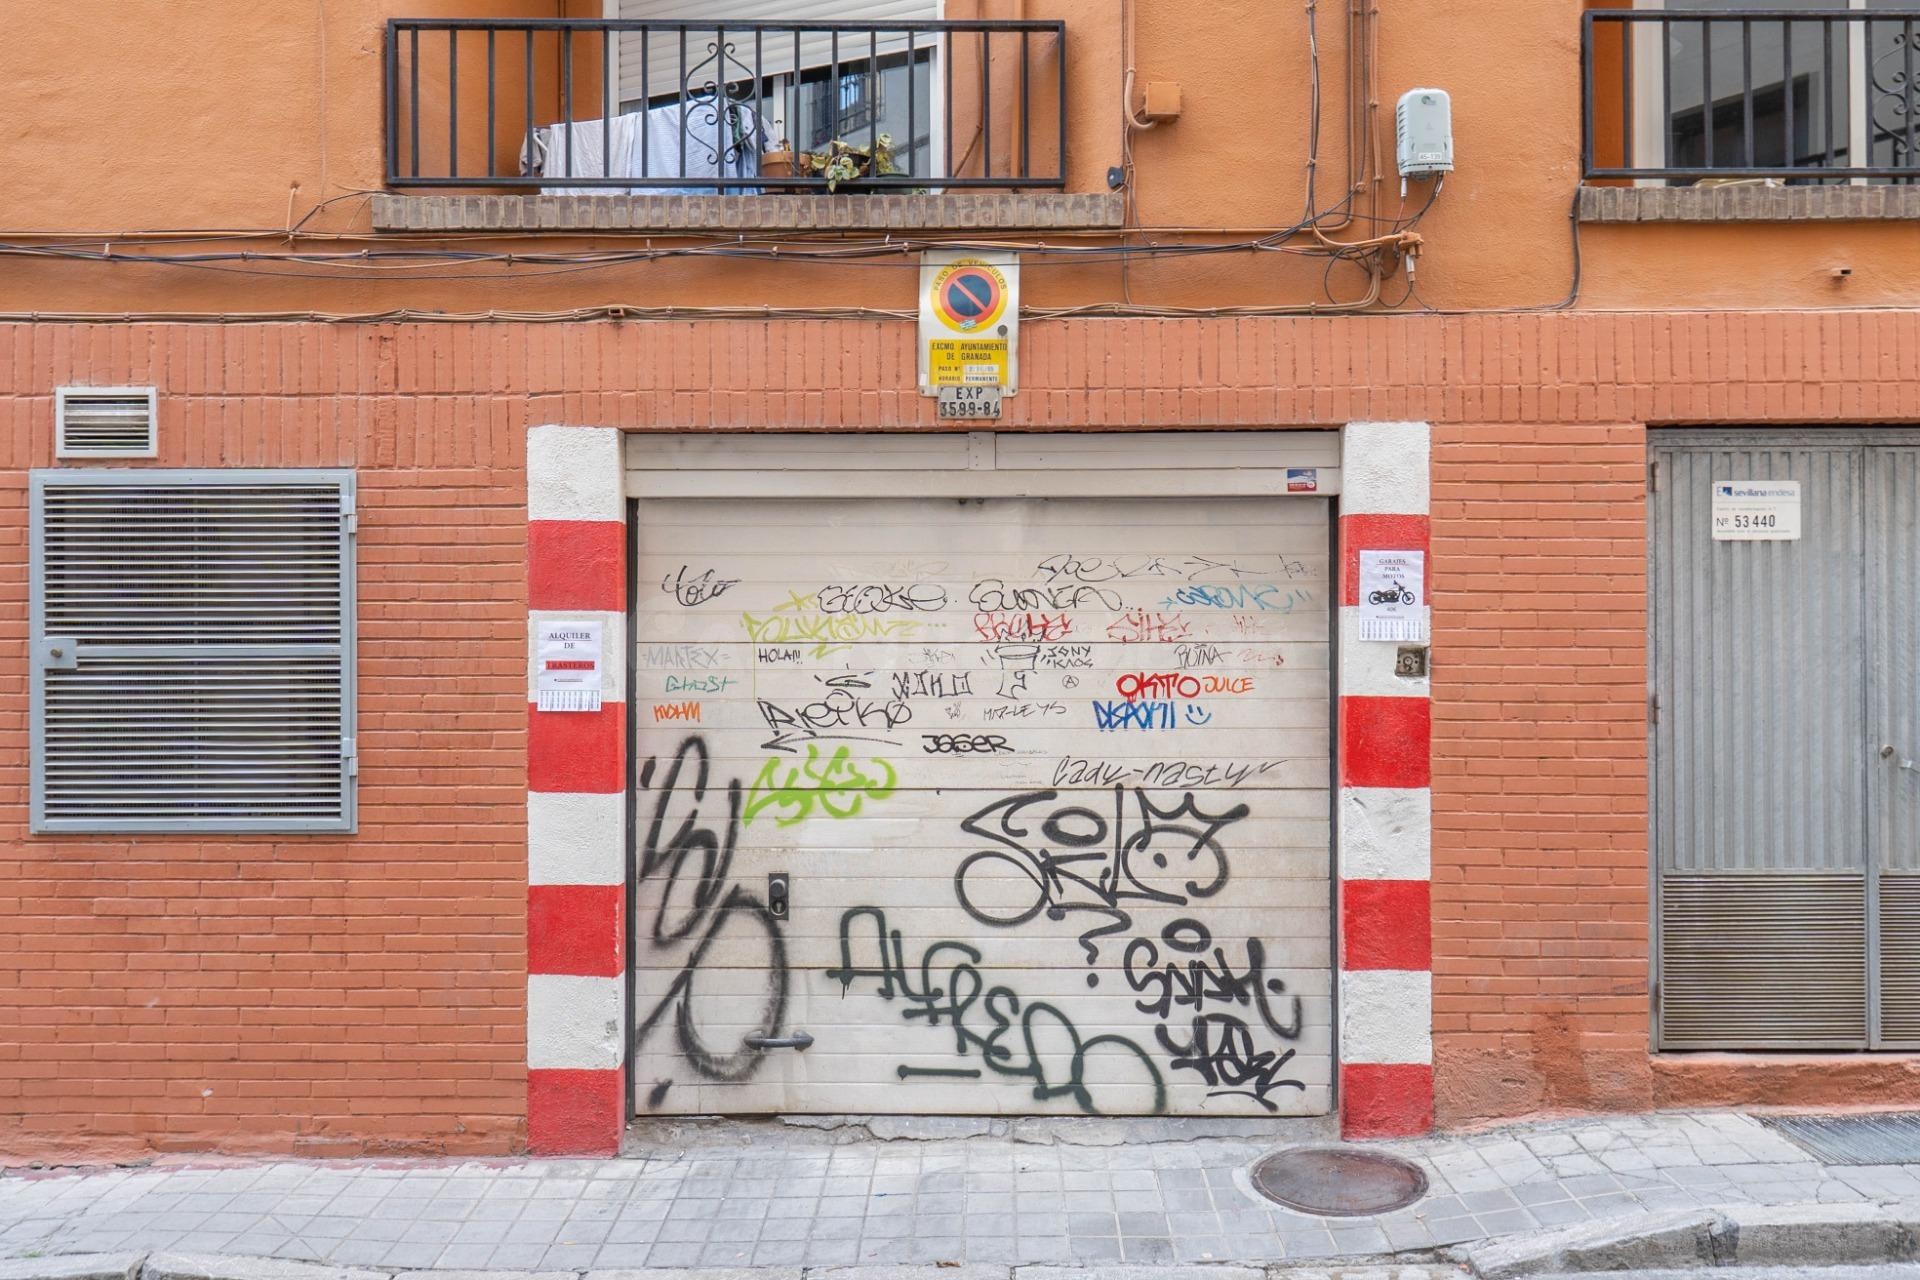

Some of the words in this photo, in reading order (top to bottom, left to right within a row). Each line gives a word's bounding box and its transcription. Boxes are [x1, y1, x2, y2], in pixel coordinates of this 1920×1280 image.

[960, 343, 1008, 351] AYUNTAMIENTO
[946, 353, 955, 361] DE
[961, 353, 992, 361] GRANADA
[956, 387, 983, 400] EXP
[940, 401, 1000, 417] 3599-84
[548, 632, 591, 640] ALQUILER
